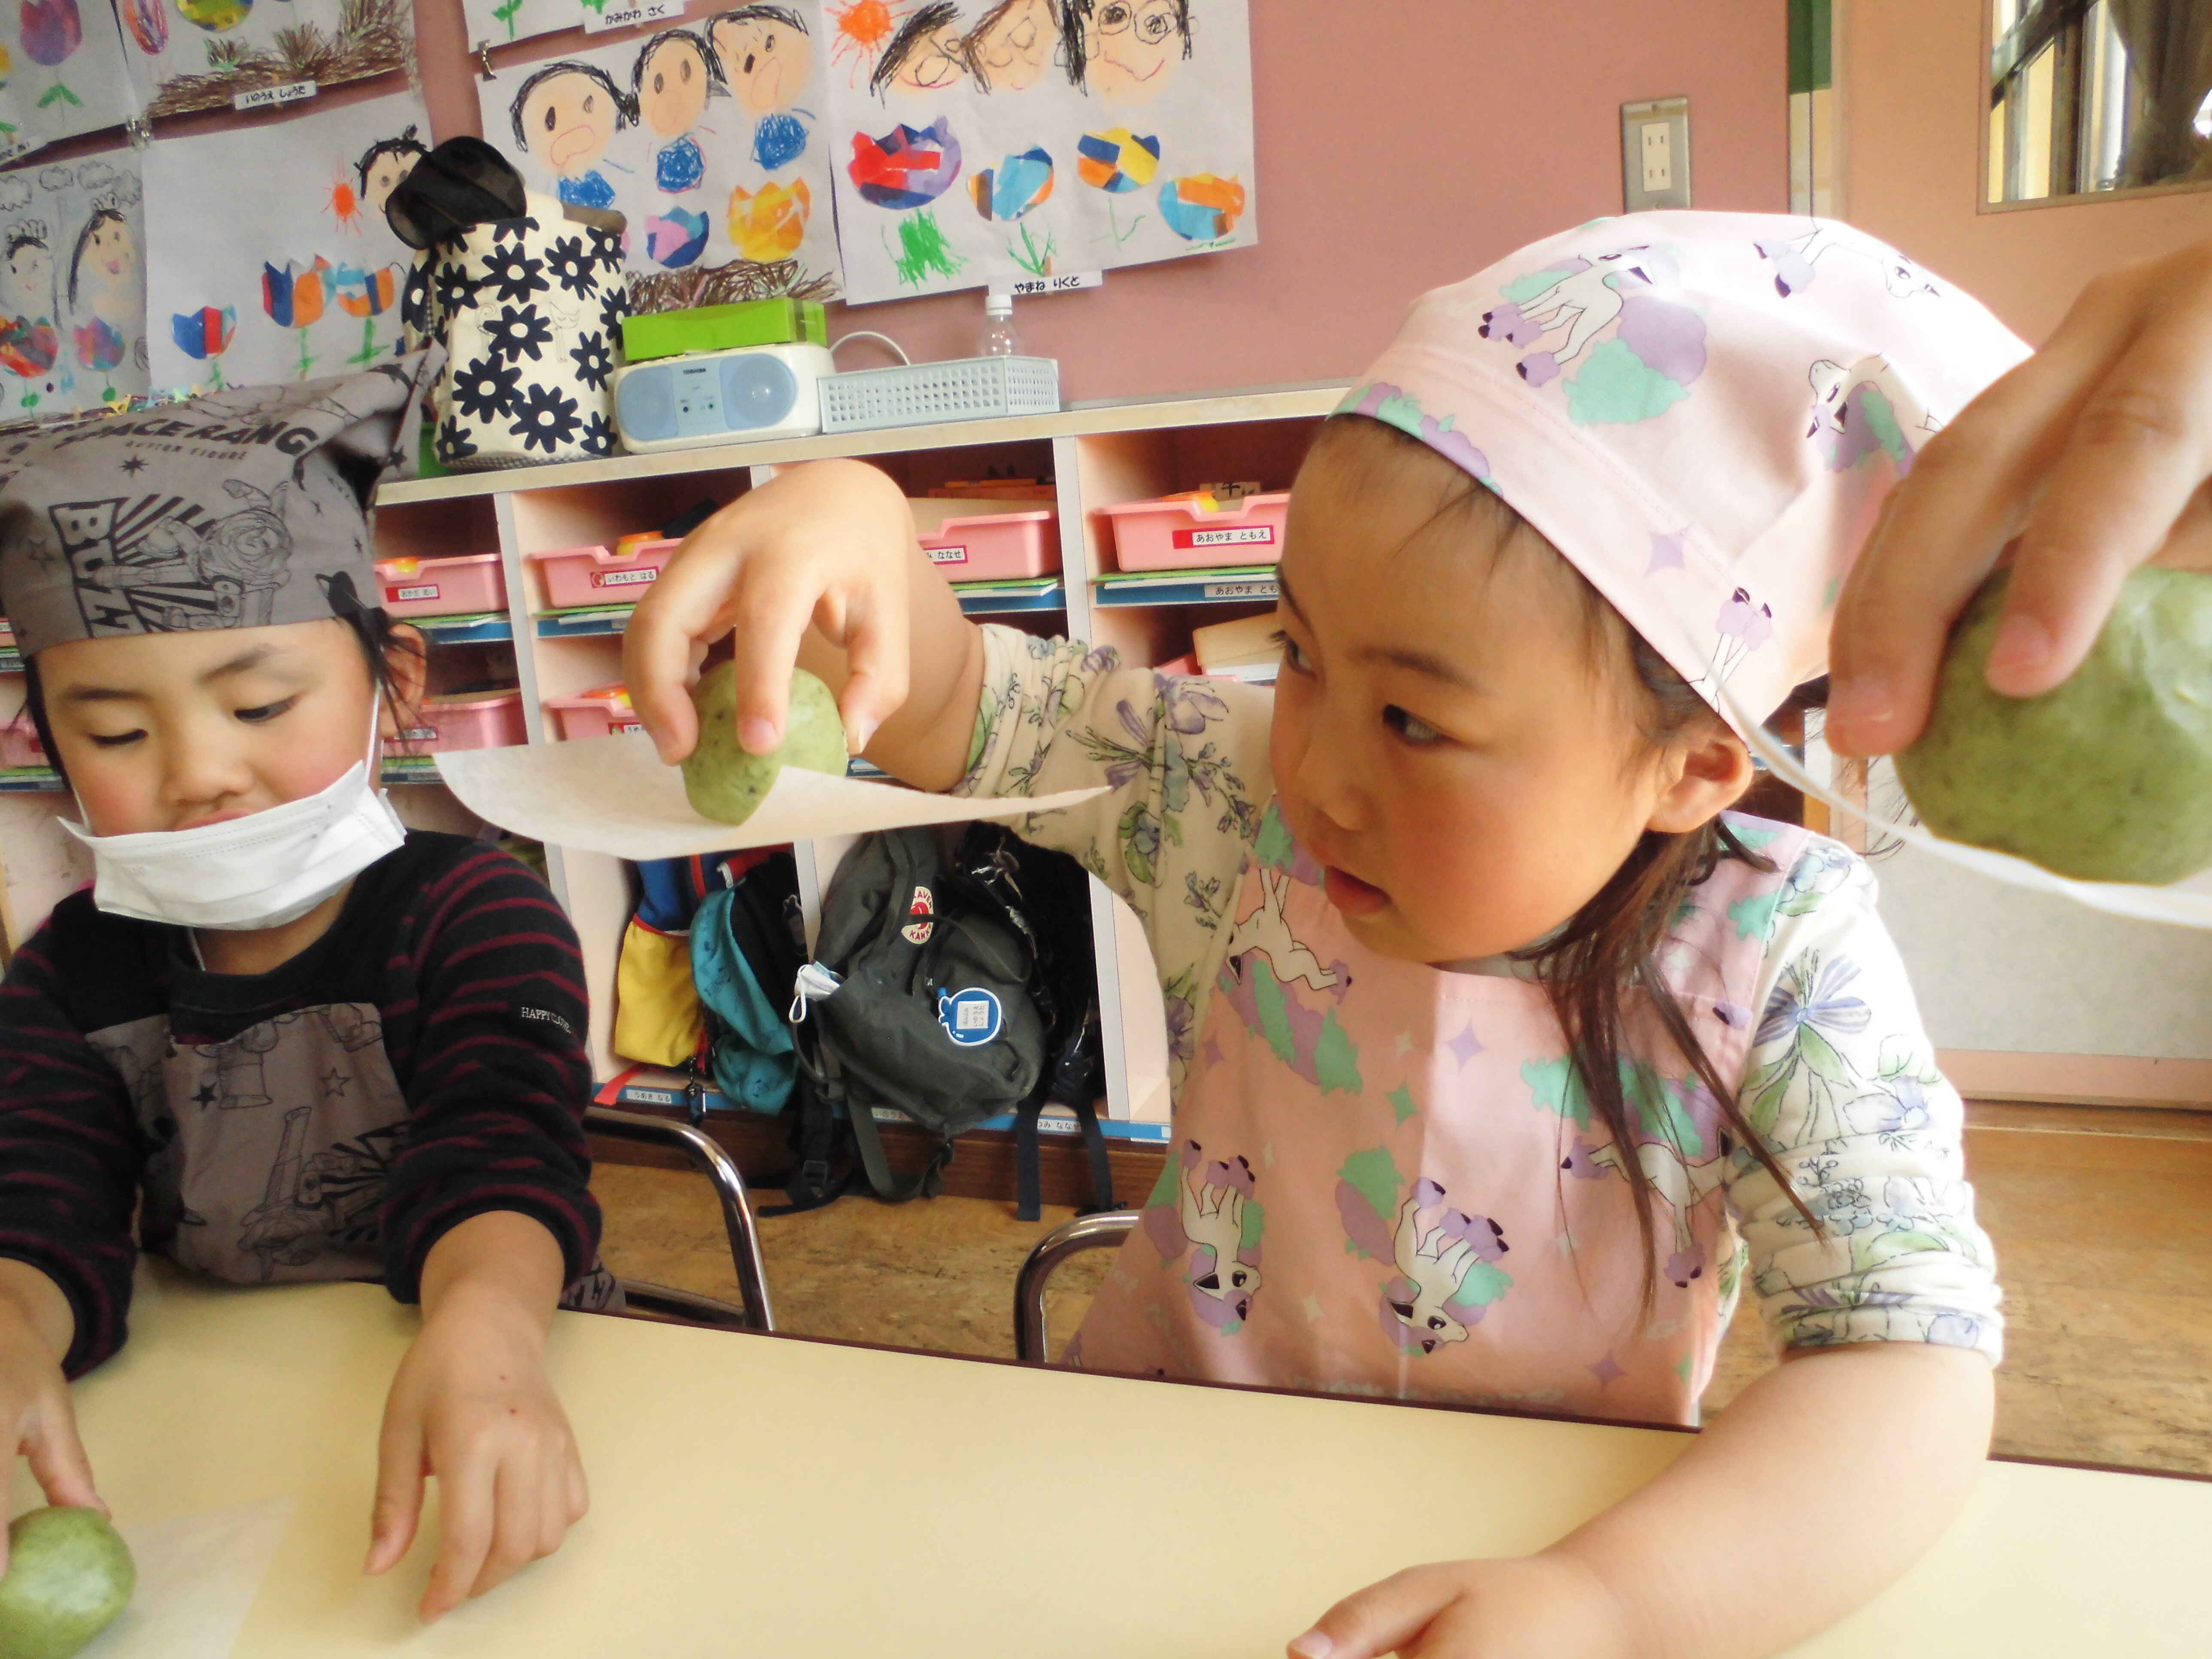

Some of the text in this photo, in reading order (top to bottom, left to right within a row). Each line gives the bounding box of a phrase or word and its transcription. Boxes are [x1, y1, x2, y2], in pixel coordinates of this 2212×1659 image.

[605, 4, 665, 24] かみかわ さく
[1015, 276, 1080, 293] やまね りくと
[1196, 530, 1266, 543] あおやま ともえ
[938, 550, 961, 559] ななせ
[1215, 585, 1277, 595] あおやま とも
[521, 1007, 550, 1021] HAPPY
